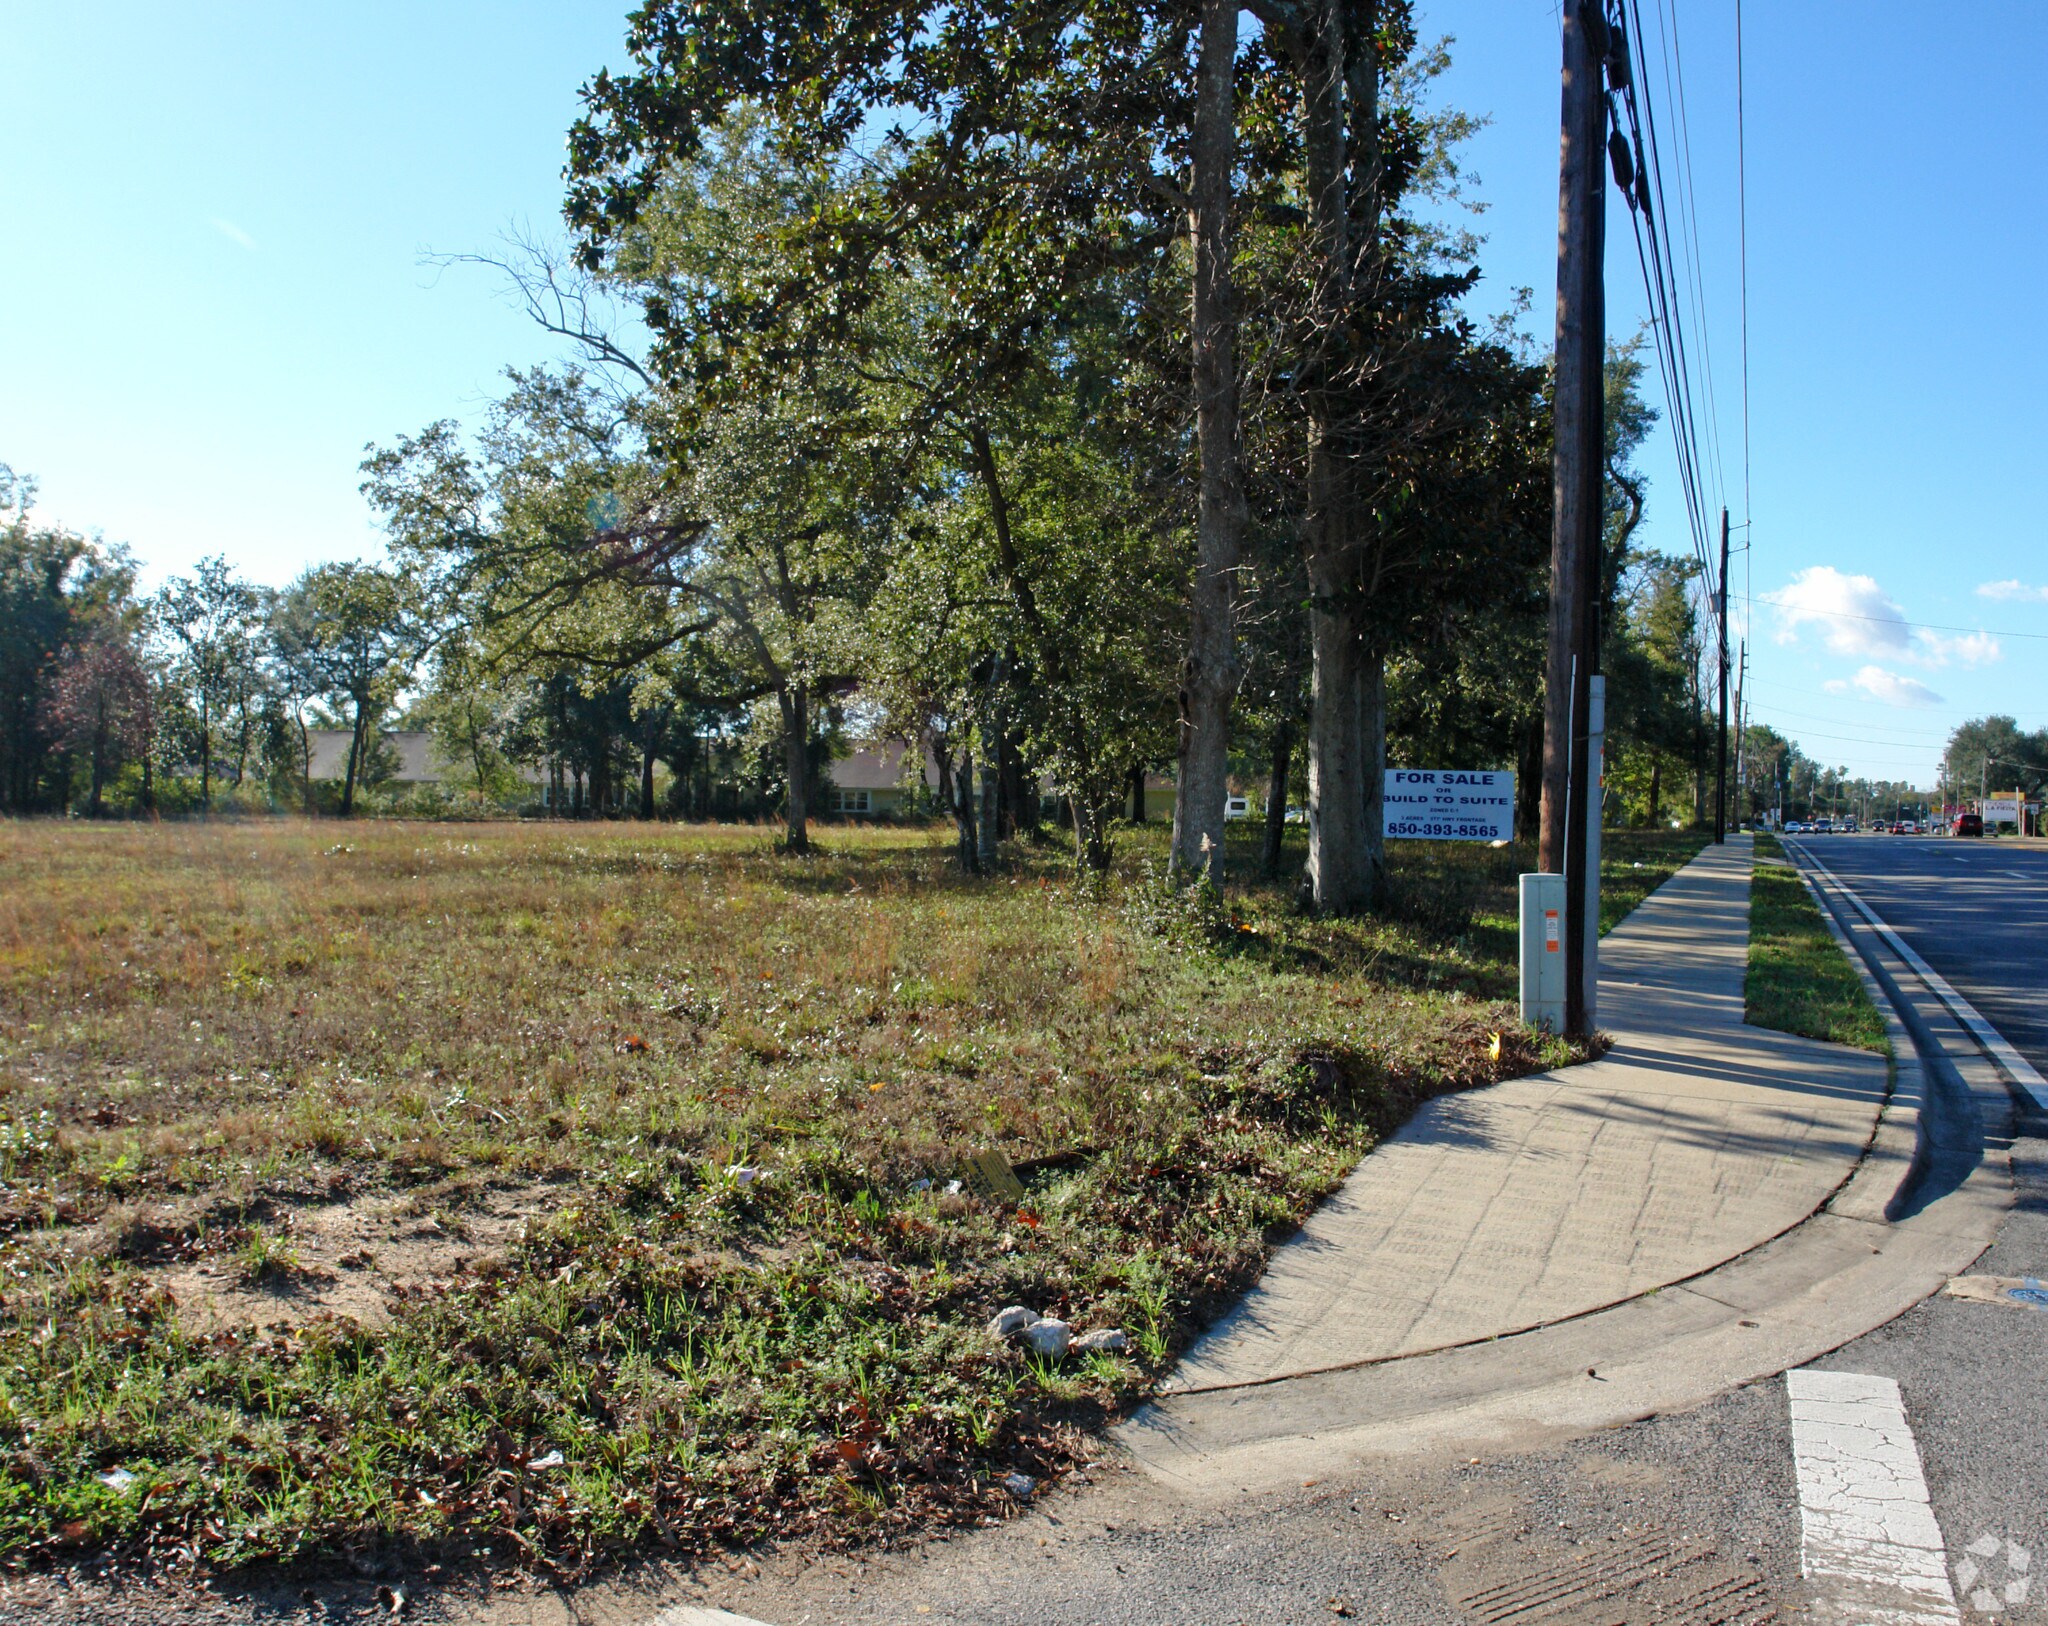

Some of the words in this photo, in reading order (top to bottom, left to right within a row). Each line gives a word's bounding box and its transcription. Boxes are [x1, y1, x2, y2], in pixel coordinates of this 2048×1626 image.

[1396, 772, 1435, 784] FOR
[1442, 773, 1494, 785] SALE
[1383, 795, 1428, 803] BUILD
[1433, 796, 1454, 804] TO
[1460, 797, 1508, 805] SUITE
[1388, 822, 1498, 837] 850-393-8565
